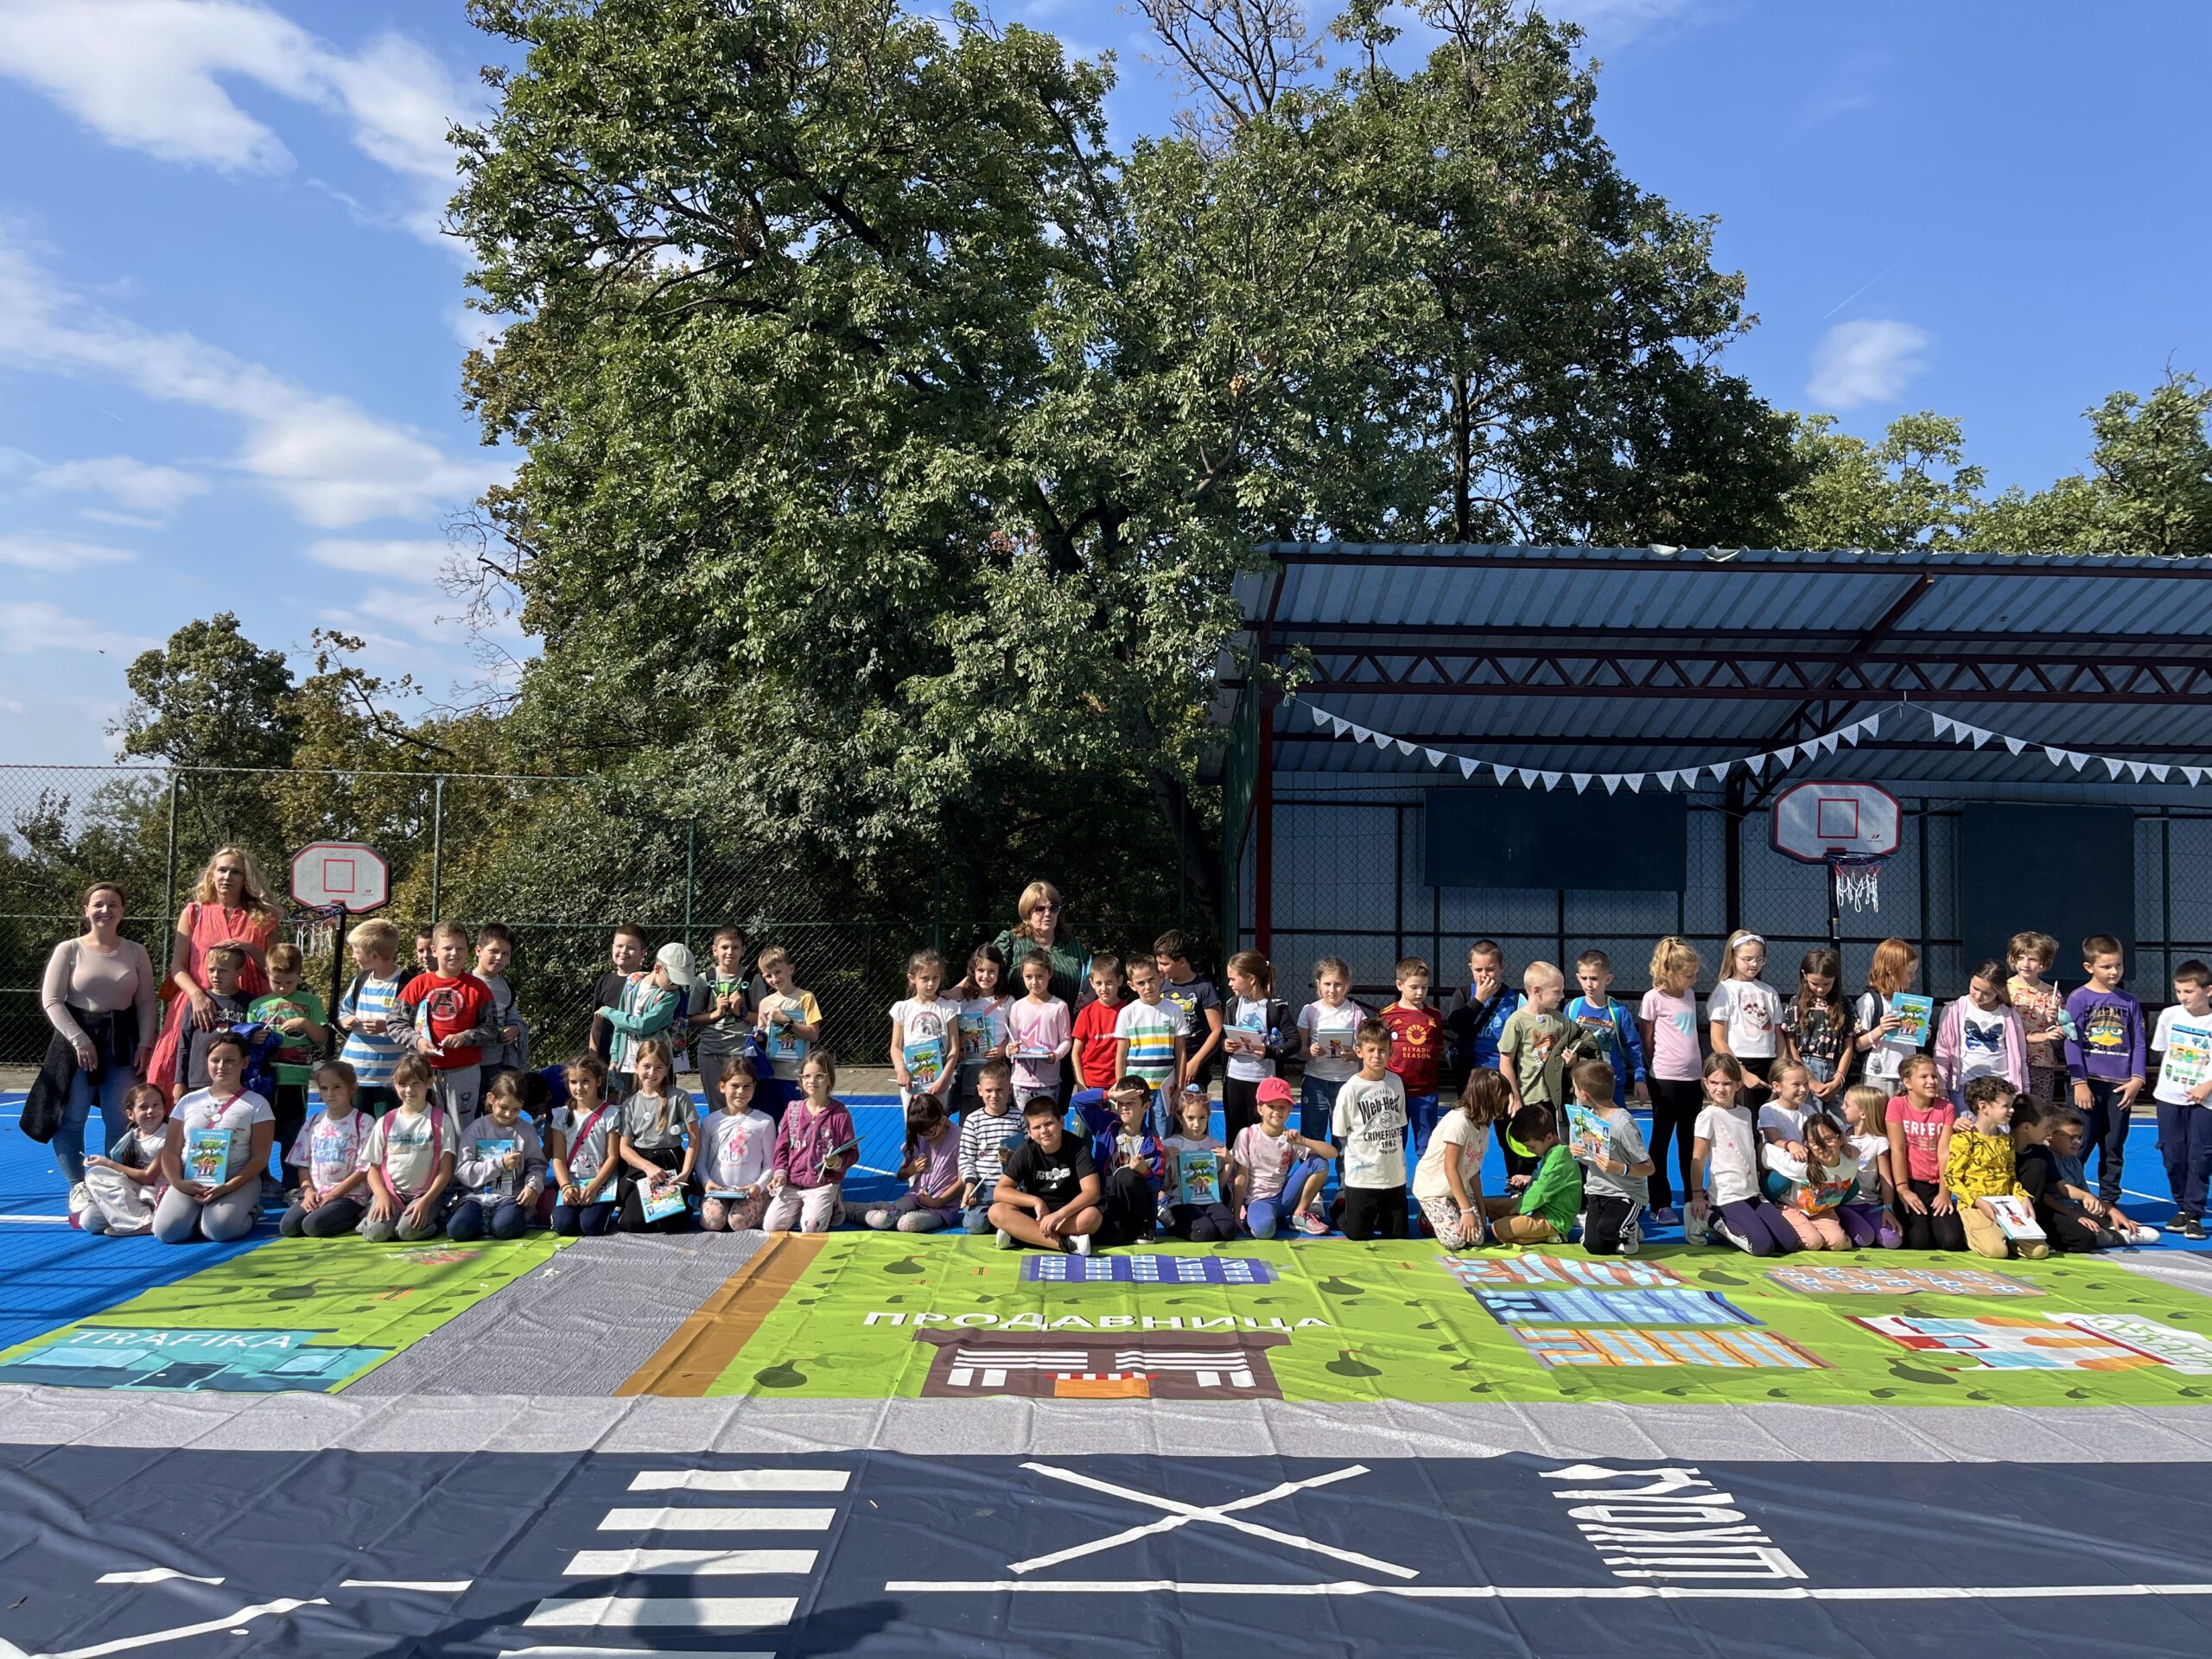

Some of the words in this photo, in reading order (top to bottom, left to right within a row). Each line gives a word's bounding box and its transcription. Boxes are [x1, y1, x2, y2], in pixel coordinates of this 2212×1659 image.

[1363, 1127, 1403, 1141] CRIMEFIGHTE
[1903, 1120, 1943, 1136] ERFEC
[863, 1312, 1334, 1332] ПРОДАВНИЦА
[69, 1332, 291, 1348] TRAFIKA
[1538, 1464, 1809, 1579] ШКОЛА
